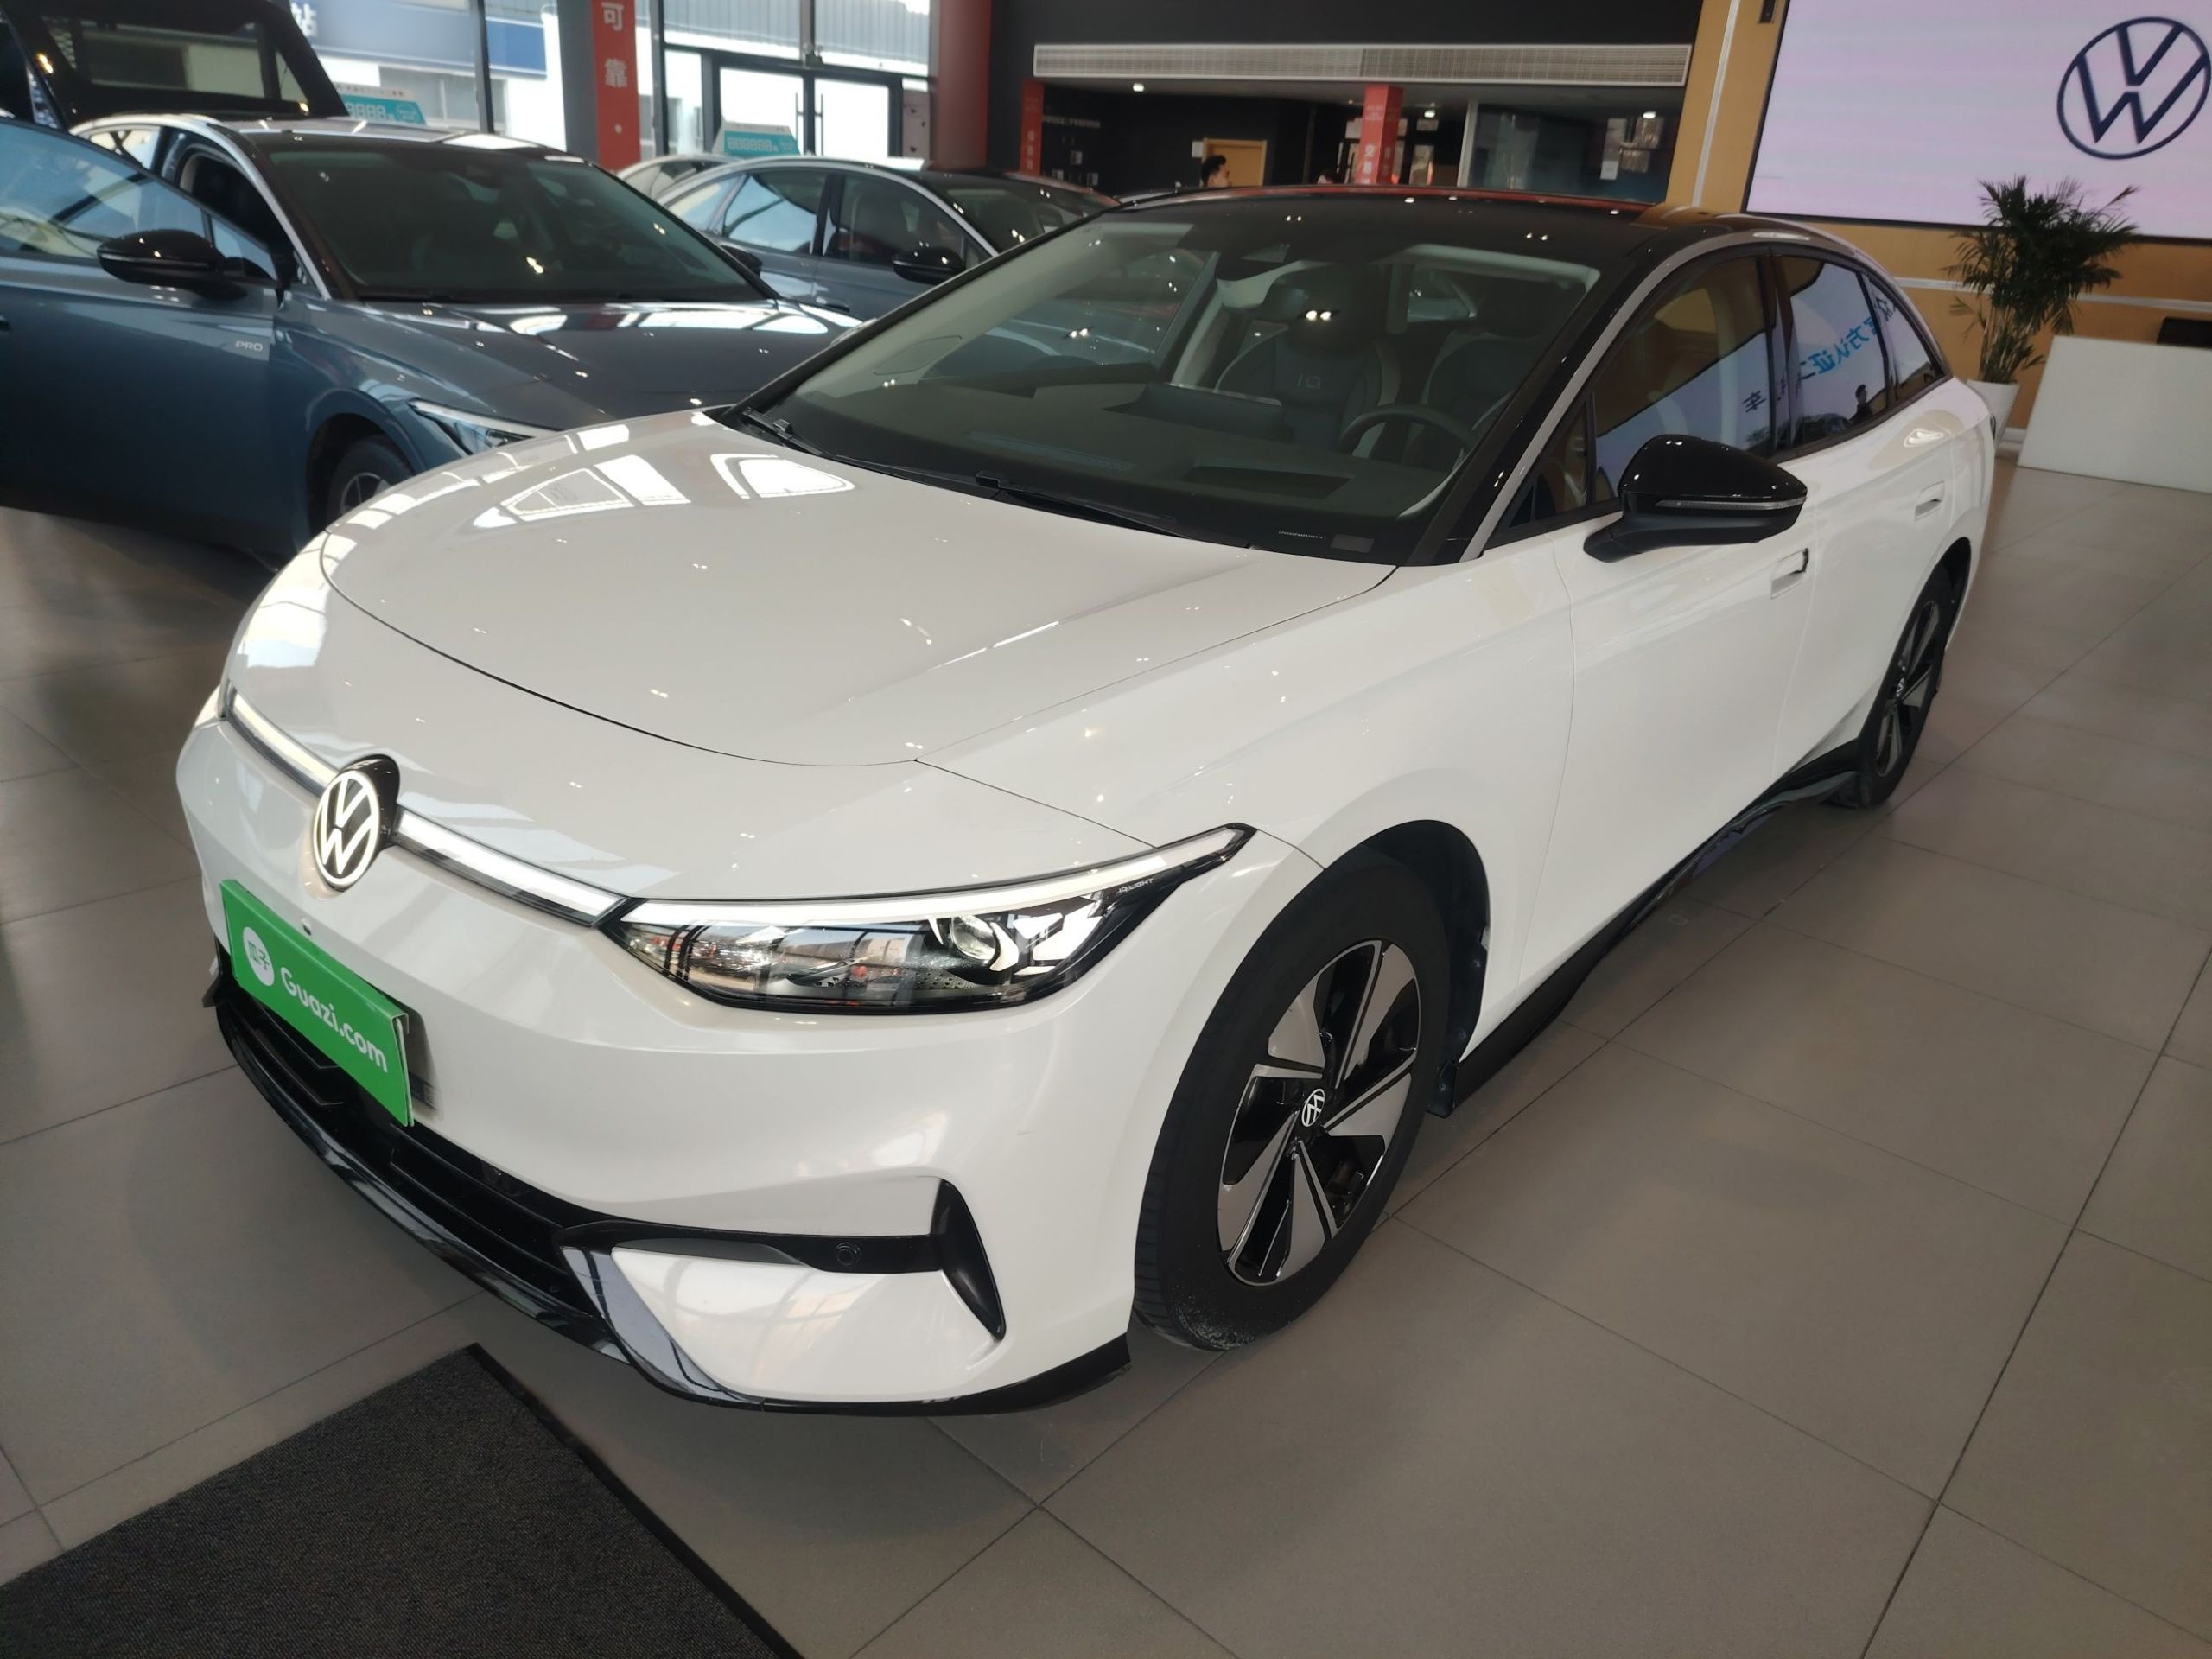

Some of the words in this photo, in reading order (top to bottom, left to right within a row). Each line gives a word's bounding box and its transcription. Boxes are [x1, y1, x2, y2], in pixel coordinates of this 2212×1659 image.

[2061, 19, 2210, 156] VW
[235, 340, 264, 352] PRO
[315, 772, 378, 884] VW
[280, 966, 388, 1073] Guazi.com
